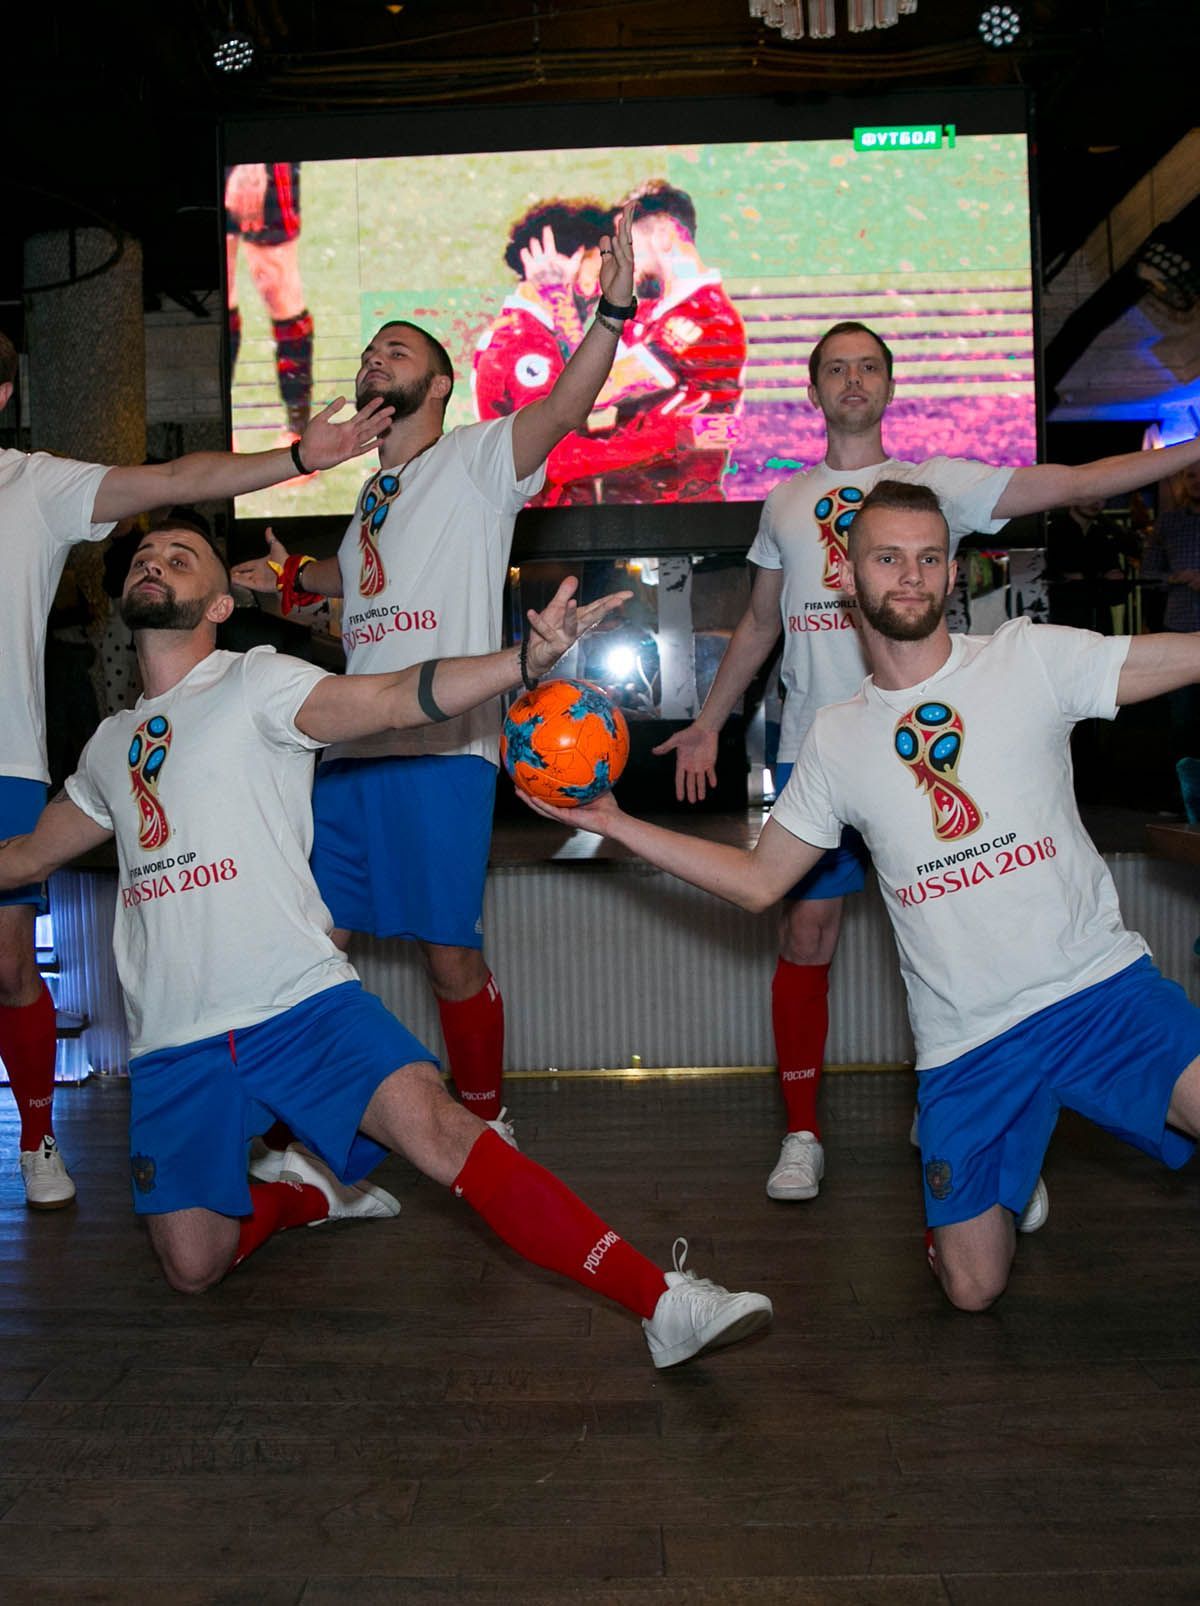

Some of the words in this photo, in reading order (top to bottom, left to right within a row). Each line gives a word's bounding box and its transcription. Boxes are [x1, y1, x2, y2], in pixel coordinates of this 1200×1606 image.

[861, 130, 937, 146] ФУТБОЛ
[943, 124, 956, 149] 1
[804, 602, 823, 611] FIFA
[349, 614, 365, 626] FIFA
[788, 612, 857, 633] RUSSIA
[142, 858, 175, 875] WORLD
[176, 852, 197, 866] CUP
[916, 859, 944, 876] FIFA
[943, 842, 992, 867] WORLD
[992, 832, 1017, 849] CUP
[179, 858, 238, 892] 2018
[895, 860, 995, 908] RUSSIA
[995, 836, 1057, 876] 2018
[783, 1068, 816, 1081] РОССИЯ
[583, 1230, 621, 1275] РОССИЯ
